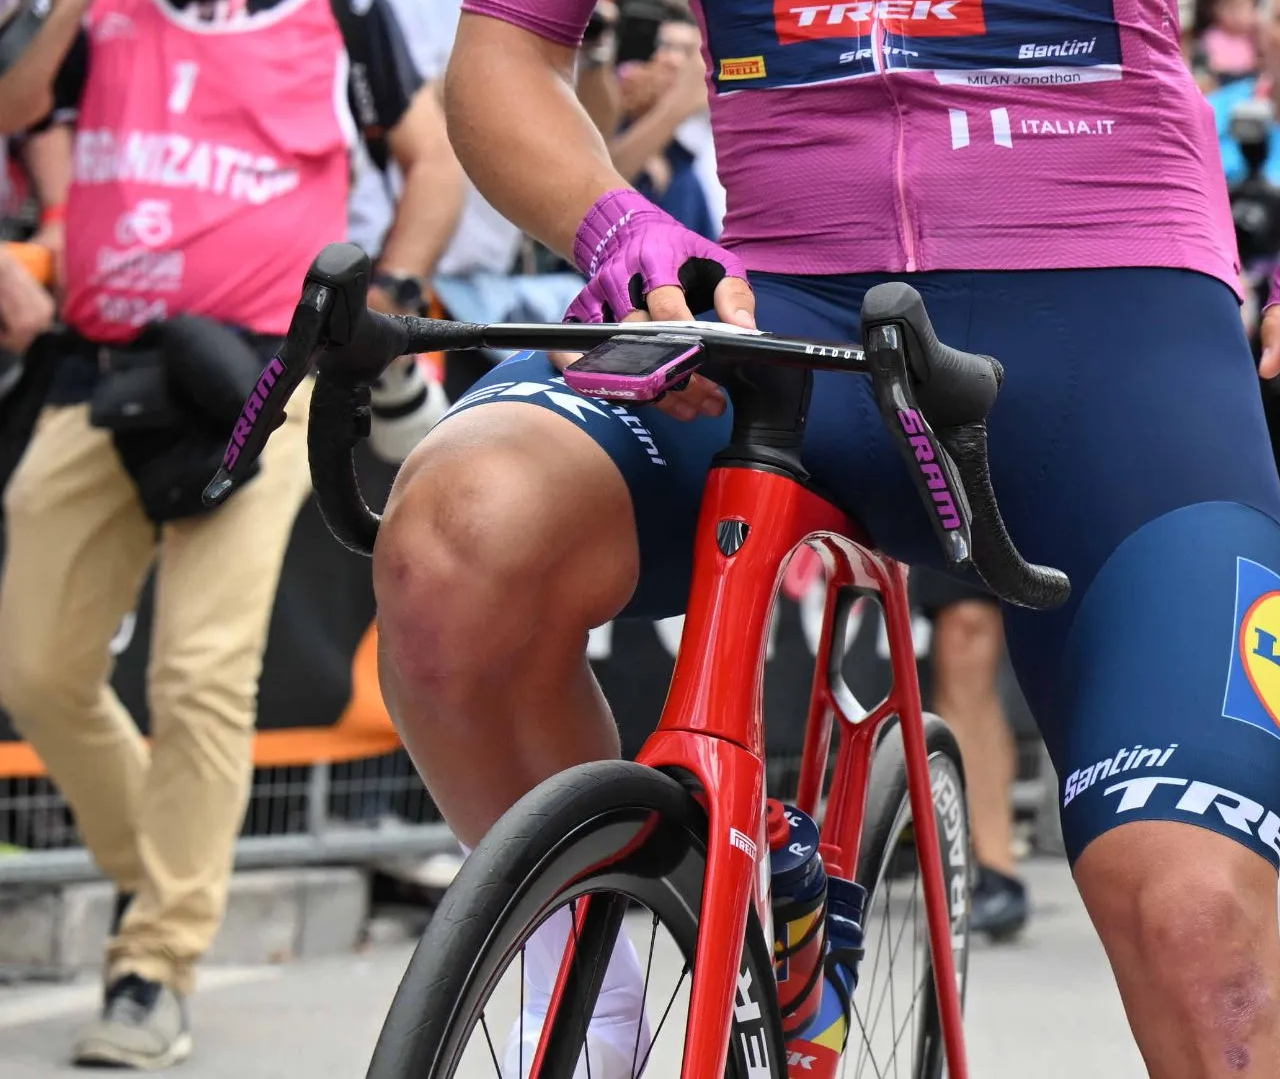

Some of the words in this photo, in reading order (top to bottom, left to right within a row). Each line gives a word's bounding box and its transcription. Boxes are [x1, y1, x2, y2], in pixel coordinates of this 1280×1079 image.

[789, 0, 963, 28] TREK
[1018, 37, 1097, 60] Santini
[967, 75, 1010, 86] MILAN
[1012, 73, 1081, 85] Jonathan
[1020, 119, 1115, 135] ITALIA.IT
[578, 386, 636, 398] wahoo
[223, 358, 285, 471] SRAM
[895, 408, 963, 530] SRAM
[1062, 743, 1179, 809] Santini
